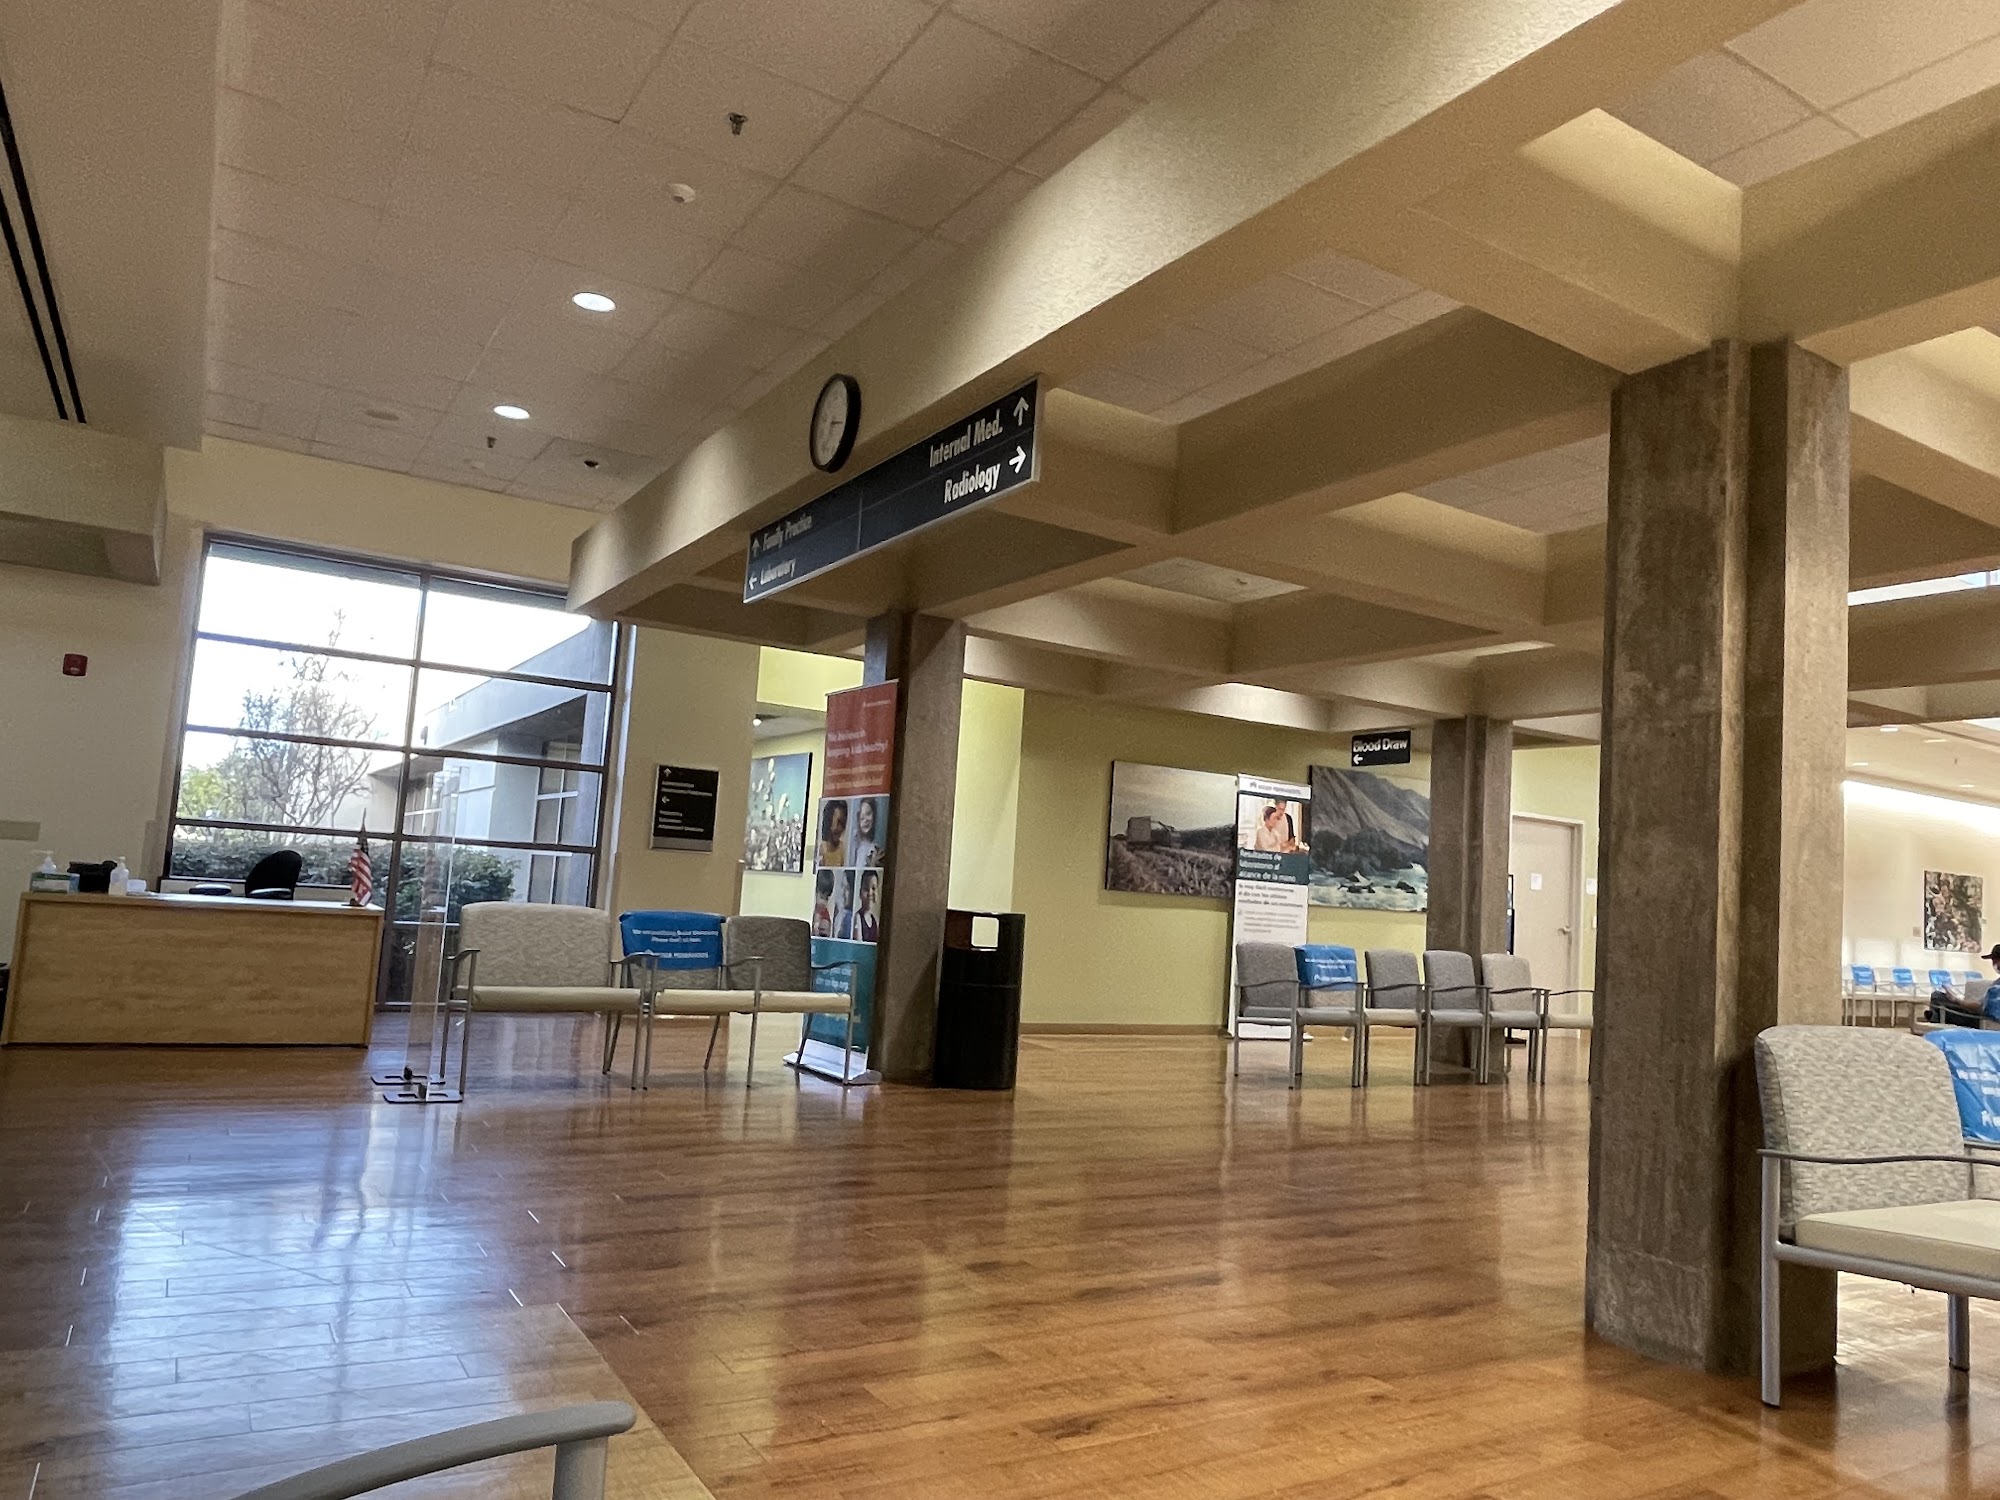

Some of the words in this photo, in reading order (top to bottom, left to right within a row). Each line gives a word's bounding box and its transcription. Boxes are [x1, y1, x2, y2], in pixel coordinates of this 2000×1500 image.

[930, 424, 971, 468] Internal
[973, 409, 1003, 446] Med.
[944, 463, 1001, 504] Radiology
[1353, 739, 1381, 753] Blood
[1382, 738, 1408, 751] Draw
